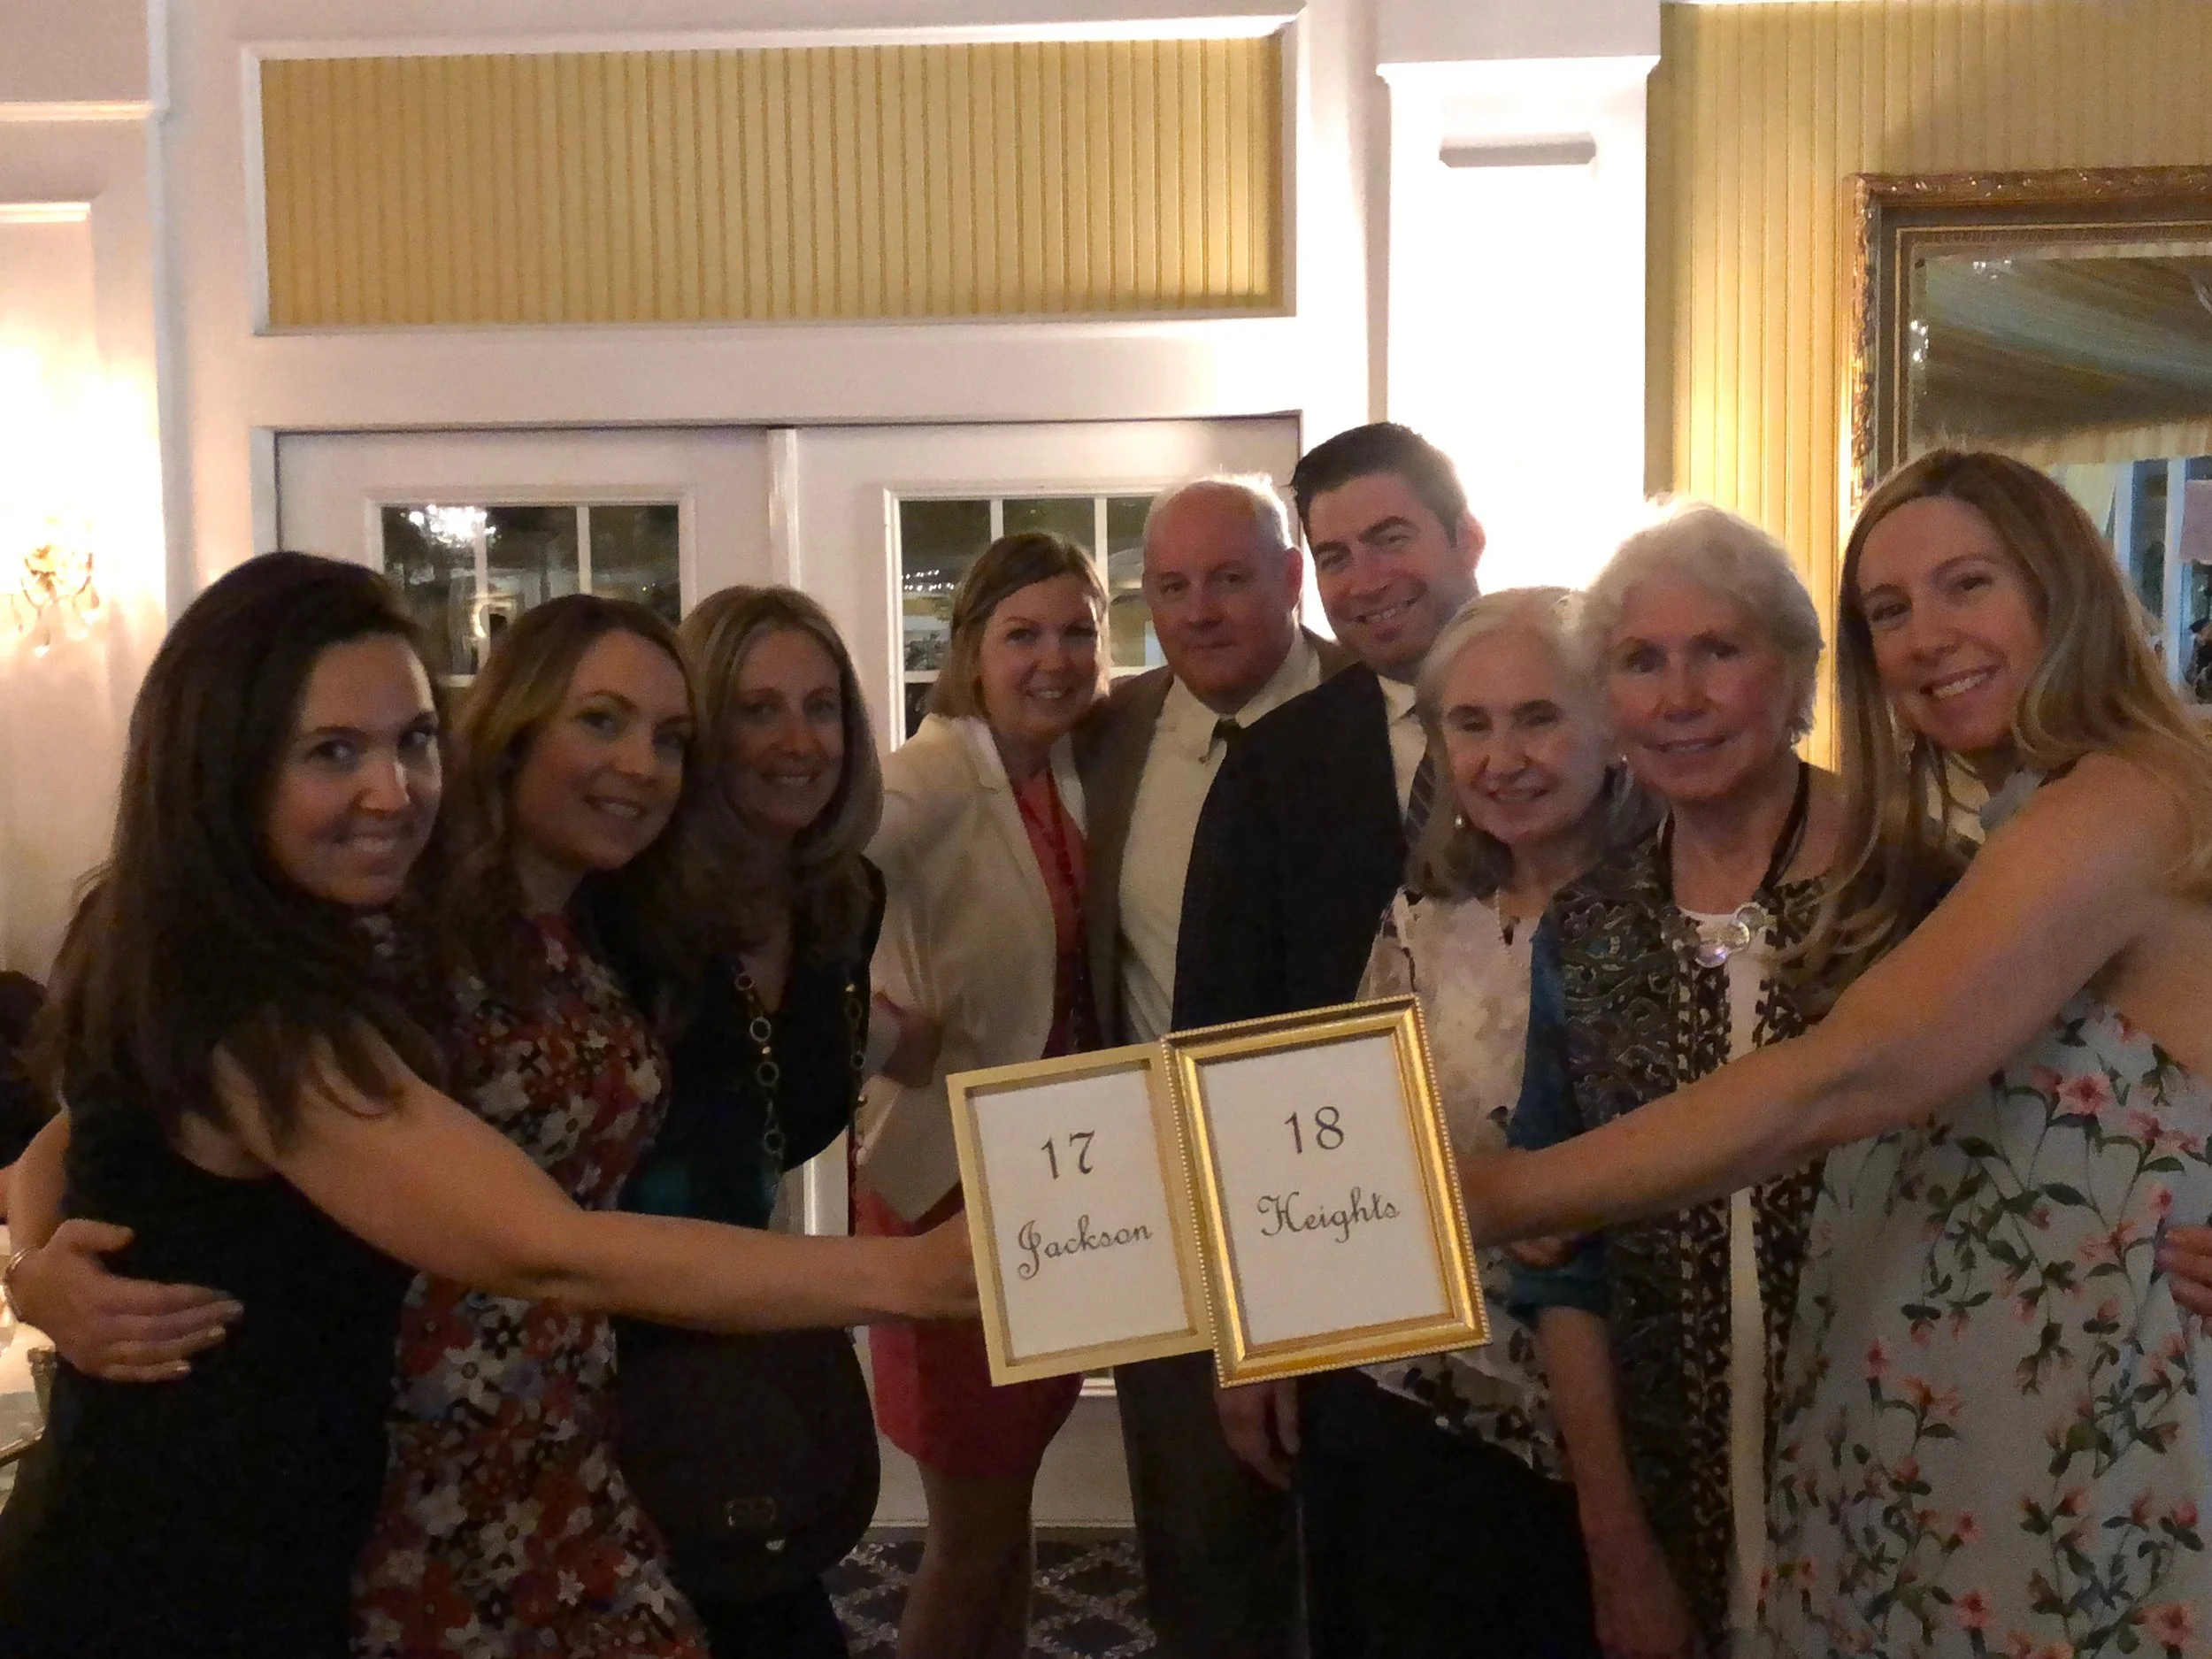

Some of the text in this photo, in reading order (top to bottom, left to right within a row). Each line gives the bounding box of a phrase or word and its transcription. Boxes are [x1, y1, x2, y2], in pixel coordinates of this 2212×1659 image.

[1040, 1130, 1095, 1181] 17
[1284, 1105, 1345, 1155] 18
[1256, 1186, 1400, 1244] Heights
[1017, 1214, 1153, 1281] Jackson
